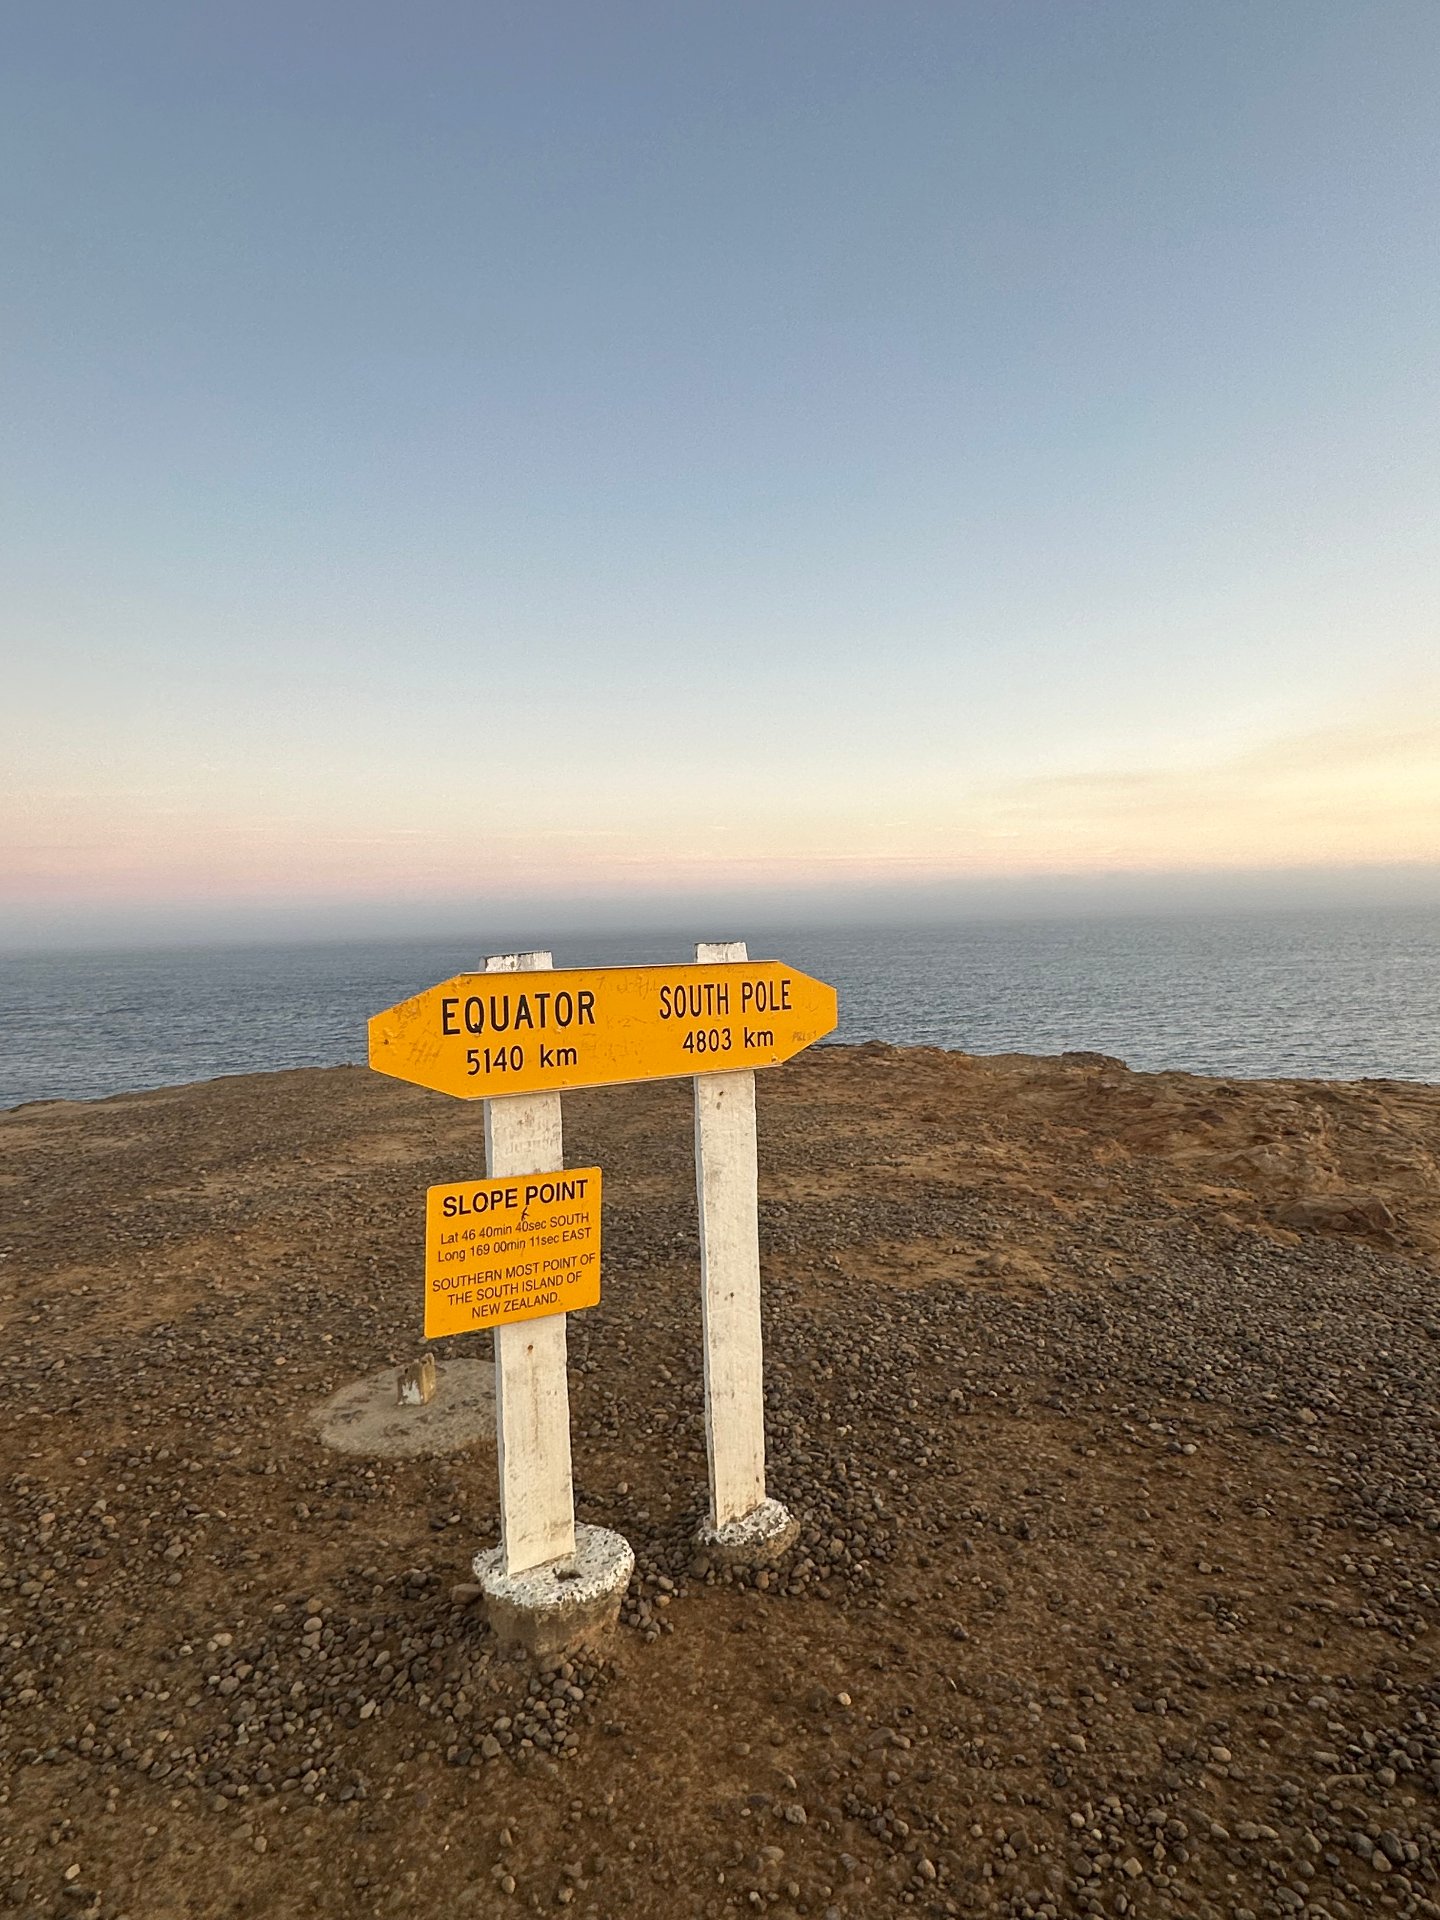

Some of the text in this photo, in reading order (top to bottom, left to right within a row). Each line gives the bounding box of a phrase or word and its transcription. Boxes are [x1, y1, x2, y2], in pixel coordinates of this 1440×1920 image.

[442, 991, 596, 1035] EQUATOR
[659, 983, 728, 1019] SOUTH
[742, 980, 792, 1013] POLE
[682, 1028, 731, 1054] 4803
[744, 1027, 774, 1049] km
[467, 1044, 577, 1076] 5140 km
[443, 1180, 588, 1217] SLOPE POINT
[438, 1227, 592, 1262] Long 169 00min 11sec EAST
[441, 1213, 589, 1244] Lat 46 40min 40sec SOUTH
[432, 1253, 596, 1292] SOUTHERN MOST POINT OF
[448, 1271, 582, 1306] THE SOUTH ISLAND OF
[472, 1303, 500, 1318] NEW
